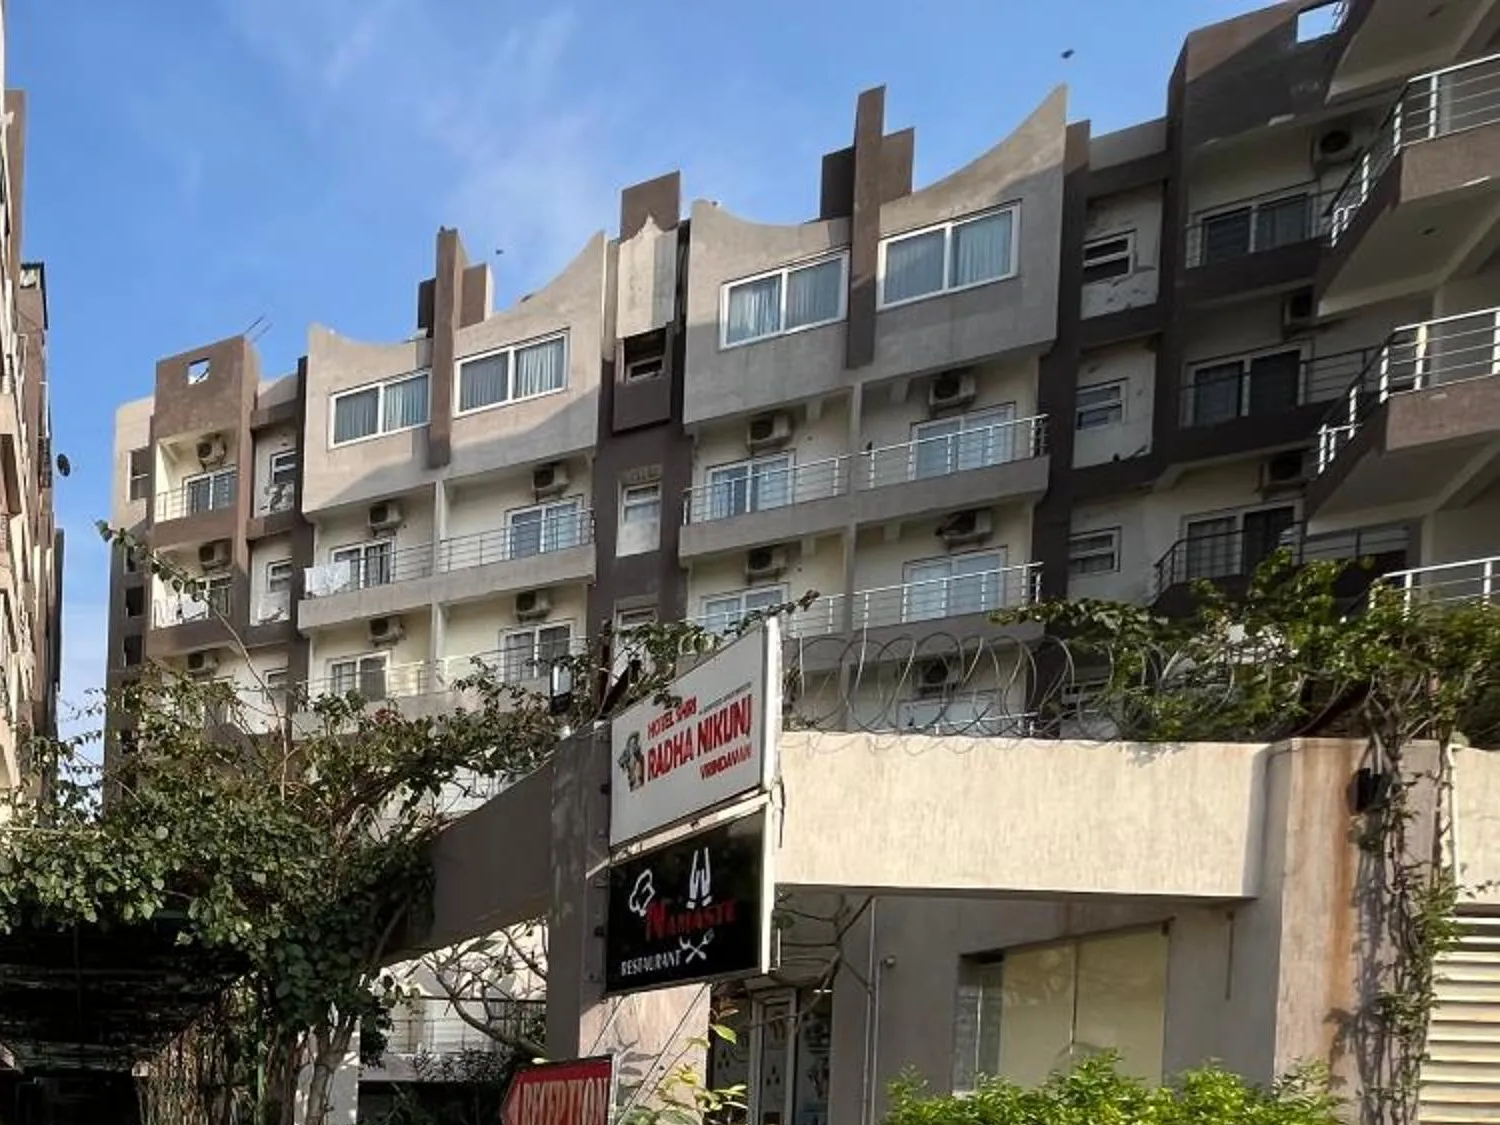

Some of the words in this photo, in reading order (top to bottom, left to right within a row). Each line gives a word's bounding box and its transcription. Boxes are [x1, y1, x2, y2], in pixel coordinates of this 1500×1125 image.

[647, 710, 675, 740] HOTEL
[647, 726, 694, 782] RADHA
[698, 693, 752, 757] NIKUNJ
[621, 949, 681, 977] RESTAURANT
